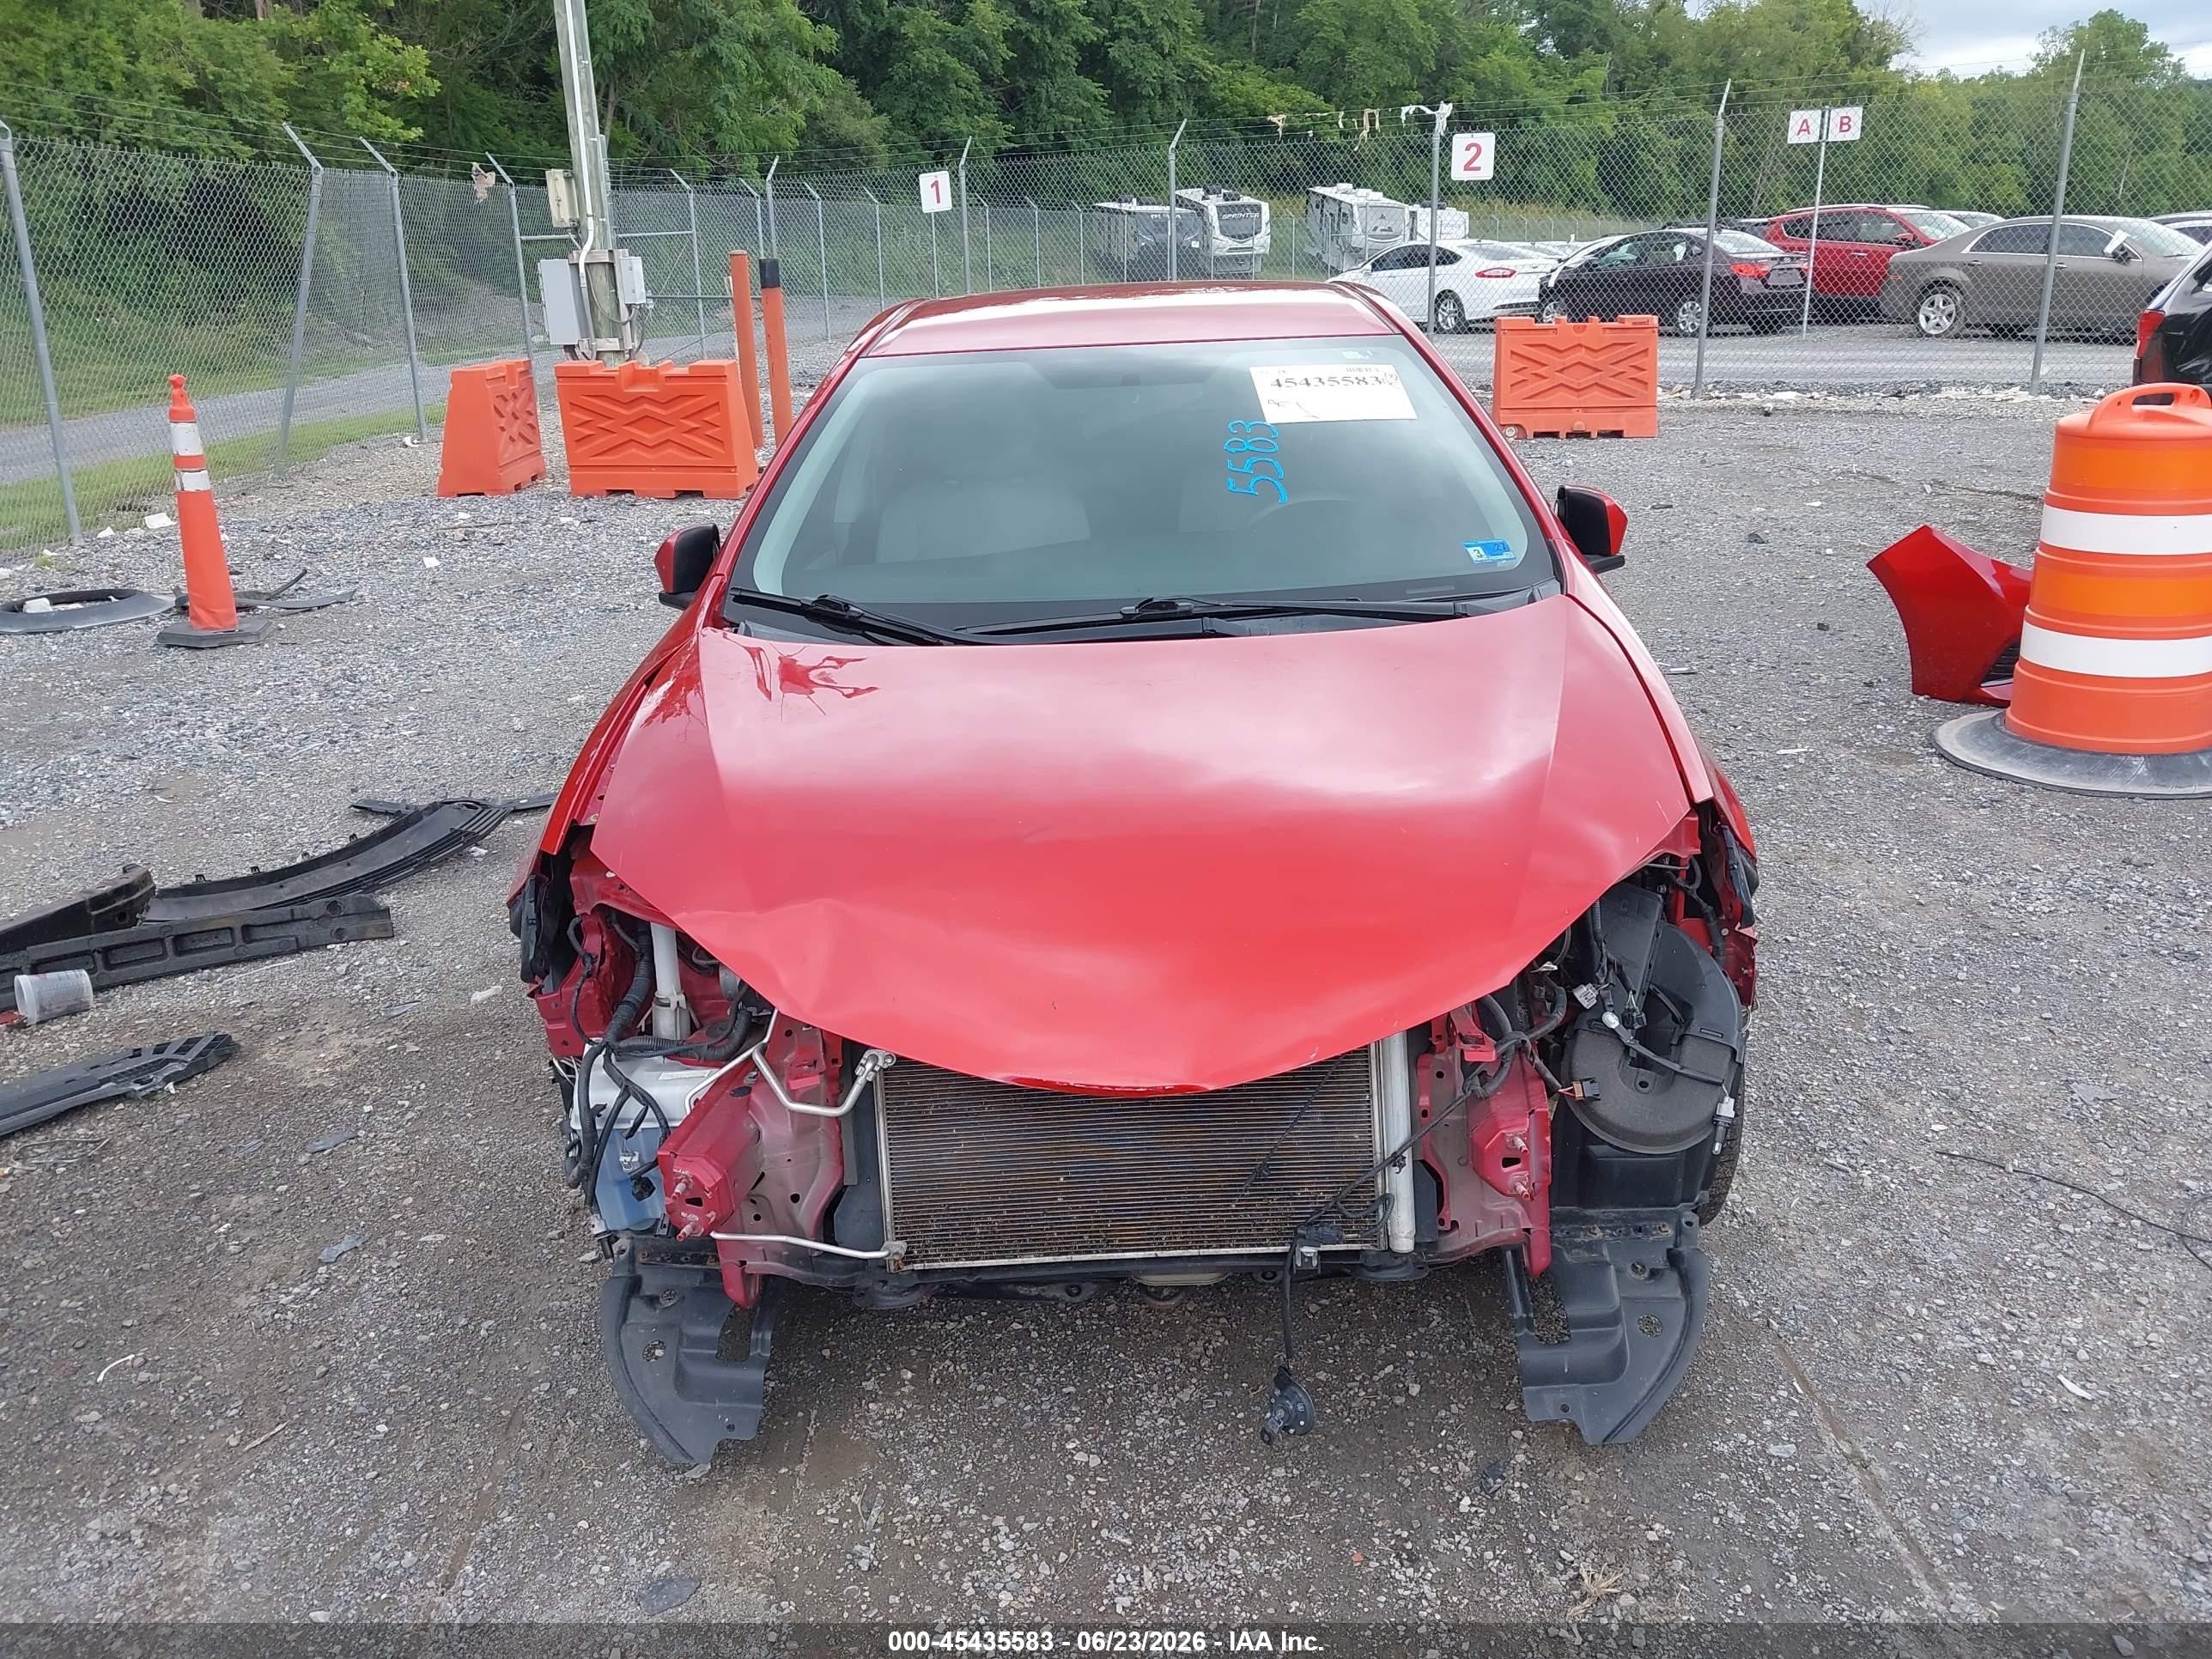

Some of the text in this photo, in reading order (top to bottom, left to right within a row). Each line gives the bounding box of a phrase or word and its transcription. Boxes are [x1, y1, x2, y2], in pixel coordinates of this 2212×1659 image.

[1796, 118, 1811, 136] A
[1838, 115, 1852, 133] B
[1463, 143, 1482, 172] 2
[930, 179, 941, 204] 1
[1270, 376, 1382, 388] 45435583
[1224, 420, 1288, 504] 5583
[1473, 549, 1484, 558] 3
